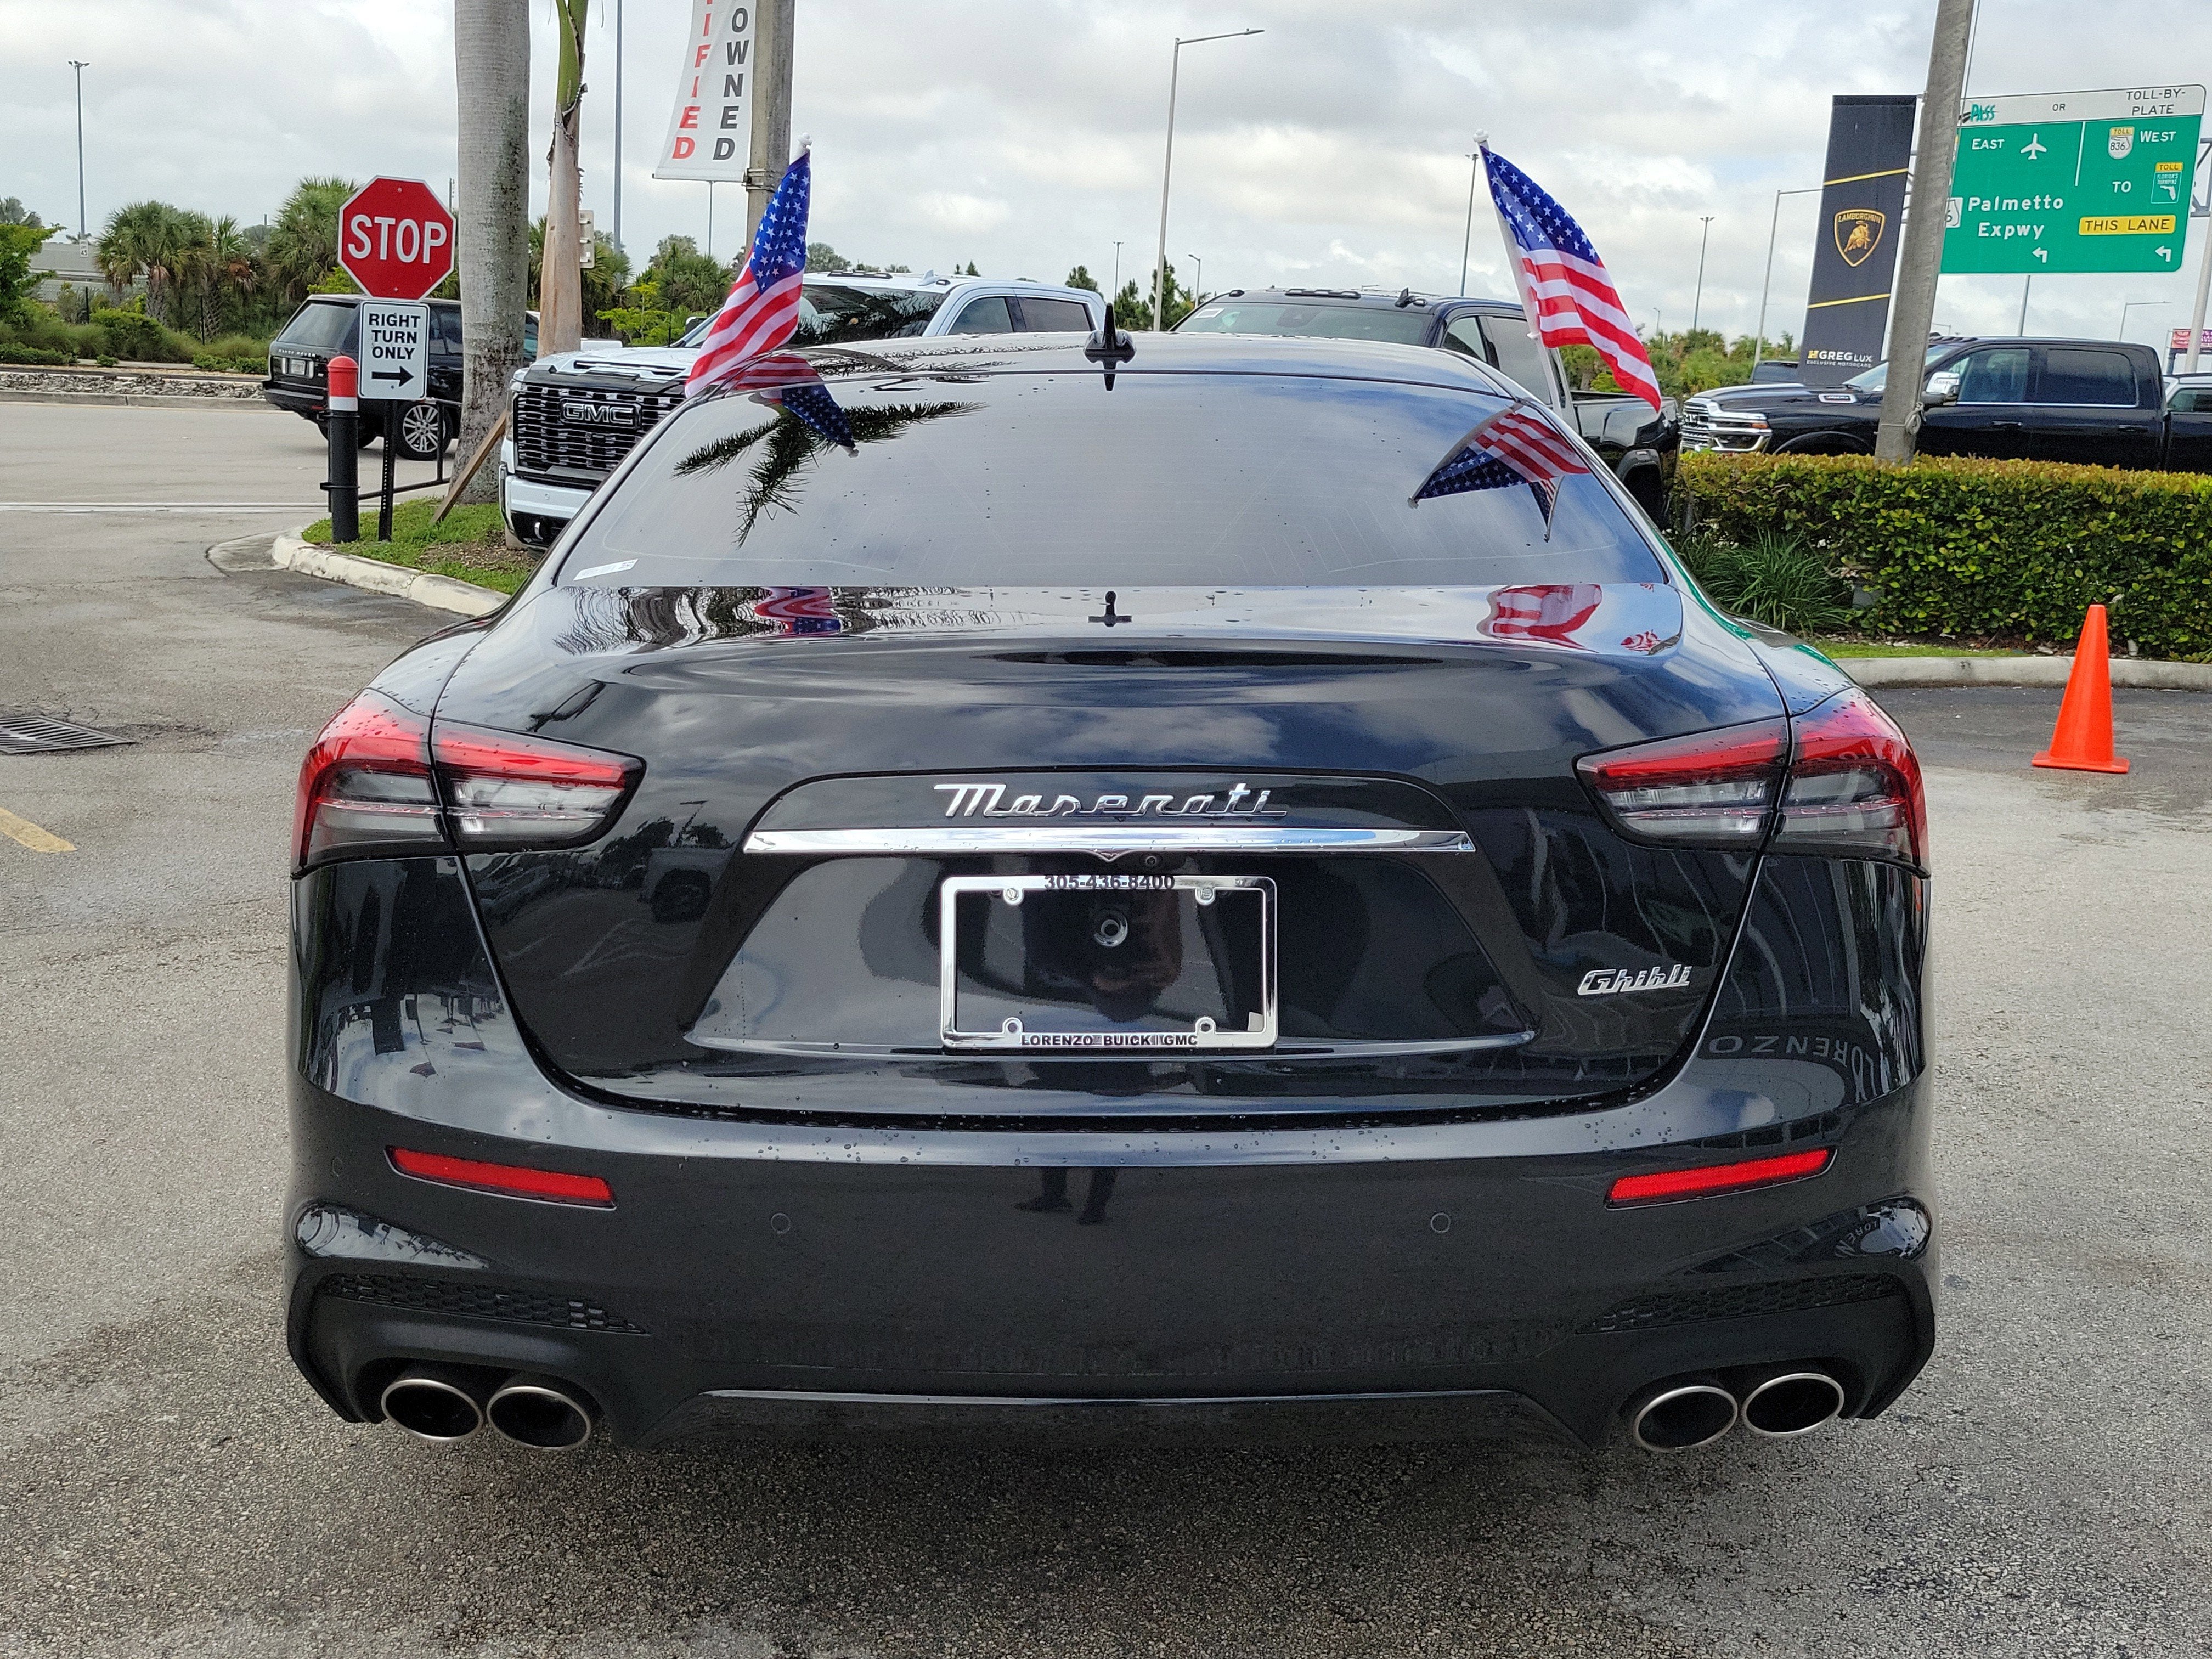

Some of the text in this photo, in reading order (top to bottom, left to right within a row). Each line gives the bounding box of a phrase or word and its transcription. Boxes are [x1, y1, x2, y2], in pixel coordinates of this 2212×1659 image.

[672, 0, 713, 159] IFIED
[2132, 104, 2174, 116] PLATE
[1972, 138, 2005, 150] EAST
[2140, 131, 2177, 143] WEST
[2110, 142, 2125, 151] 836
[2112, 181, 2131, 193] TO
[1968, 195, 2064, 212] Palmetto
[1978, 222, 2045, 240] Expwy
[2085, 219, 2170, 231] THIS LANE
[348, 214, 447, 264] STOP
[369, 313, 421, 328] RIGHT
[371, 330, 417, 344] TURN
[372, 346, 415, 359] ONLY
[563, 403, 634, 425] GMC
[933, 783, 1288, 817] Maserati
[1044, 875, 1175, 890] 305-436-8400
[1578, 964, 1692, 995] Ghibli
[1021, 1035, 1198, 1046] LORENZO BUICK GMC
